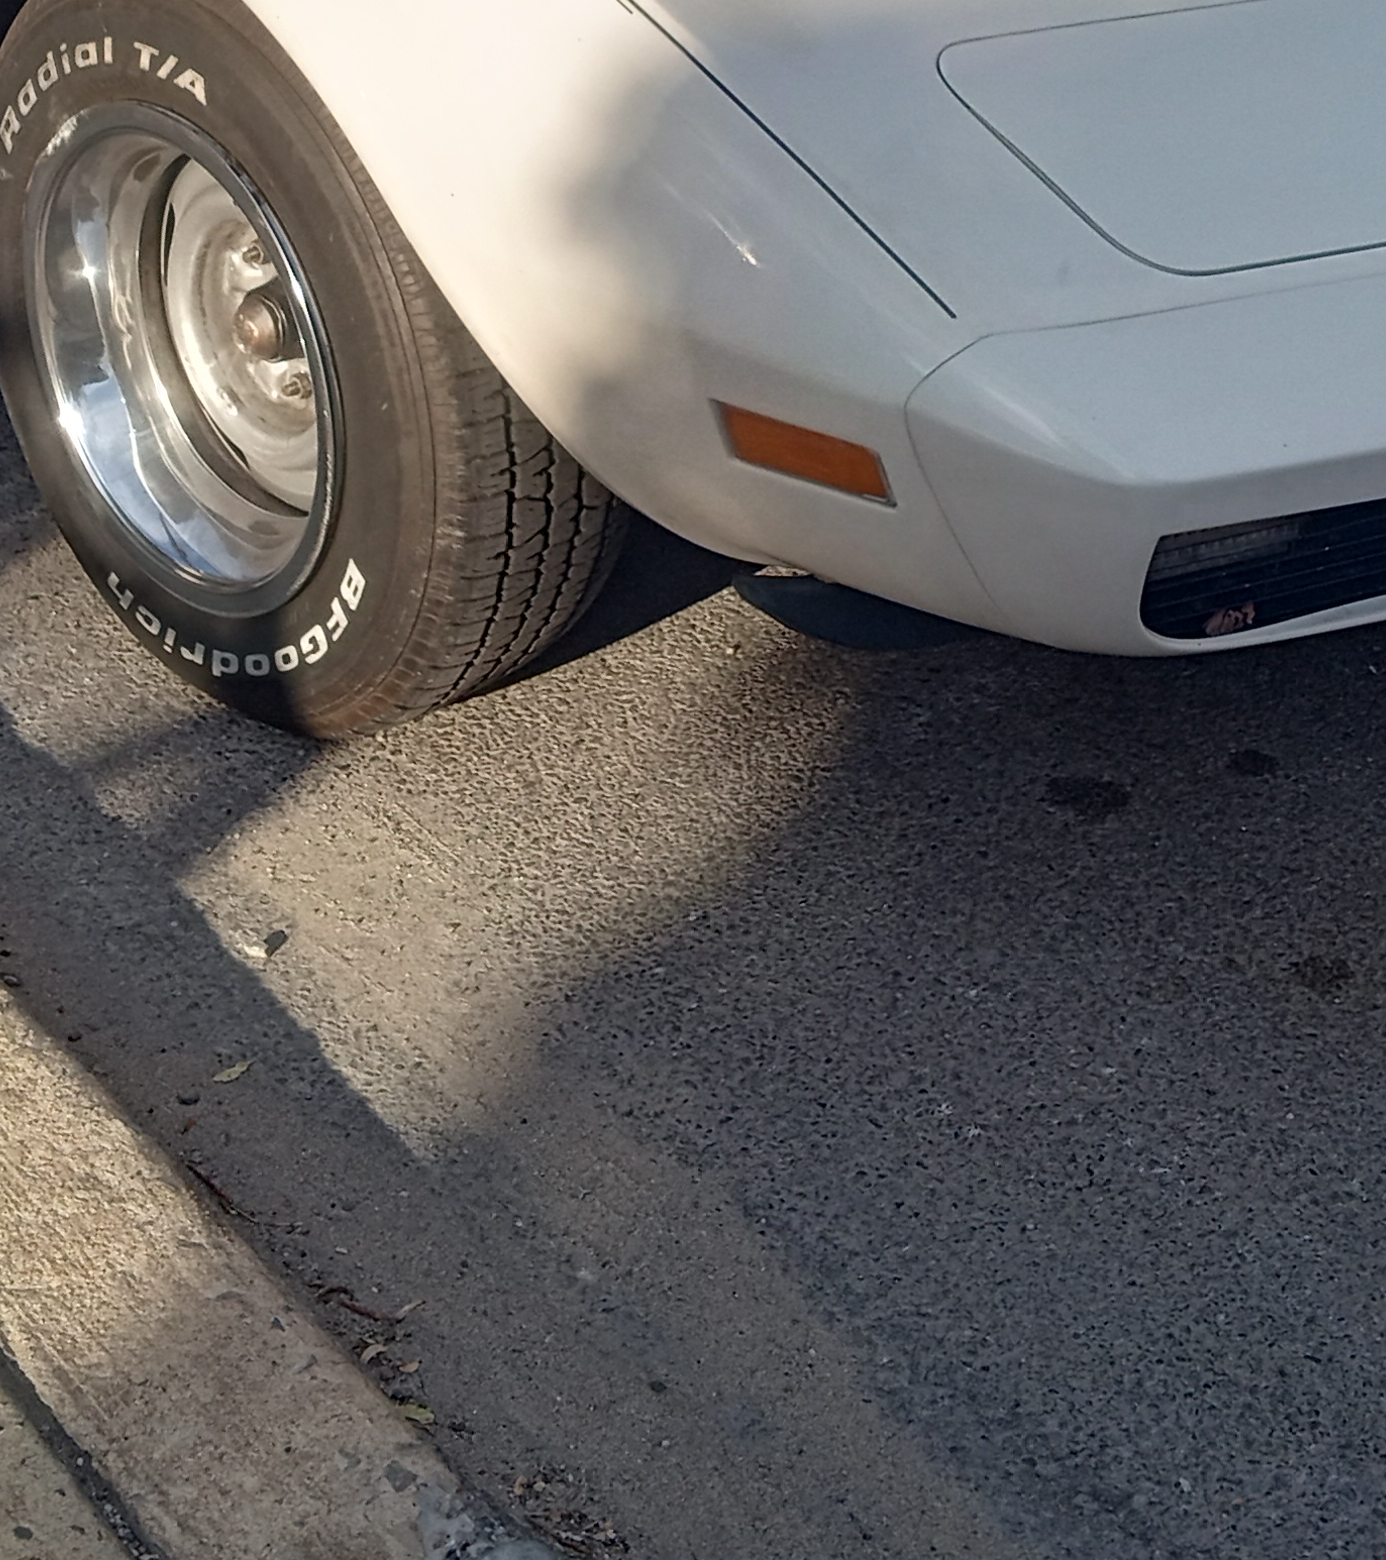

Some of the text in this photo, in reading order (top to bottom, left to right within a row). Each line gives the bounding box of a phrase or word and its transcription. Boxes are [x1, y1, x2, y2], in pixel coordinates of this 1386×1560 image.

[0, 36, 207, 154] Radial T/A
[107, 558, 366, 677] BFGoodrich
